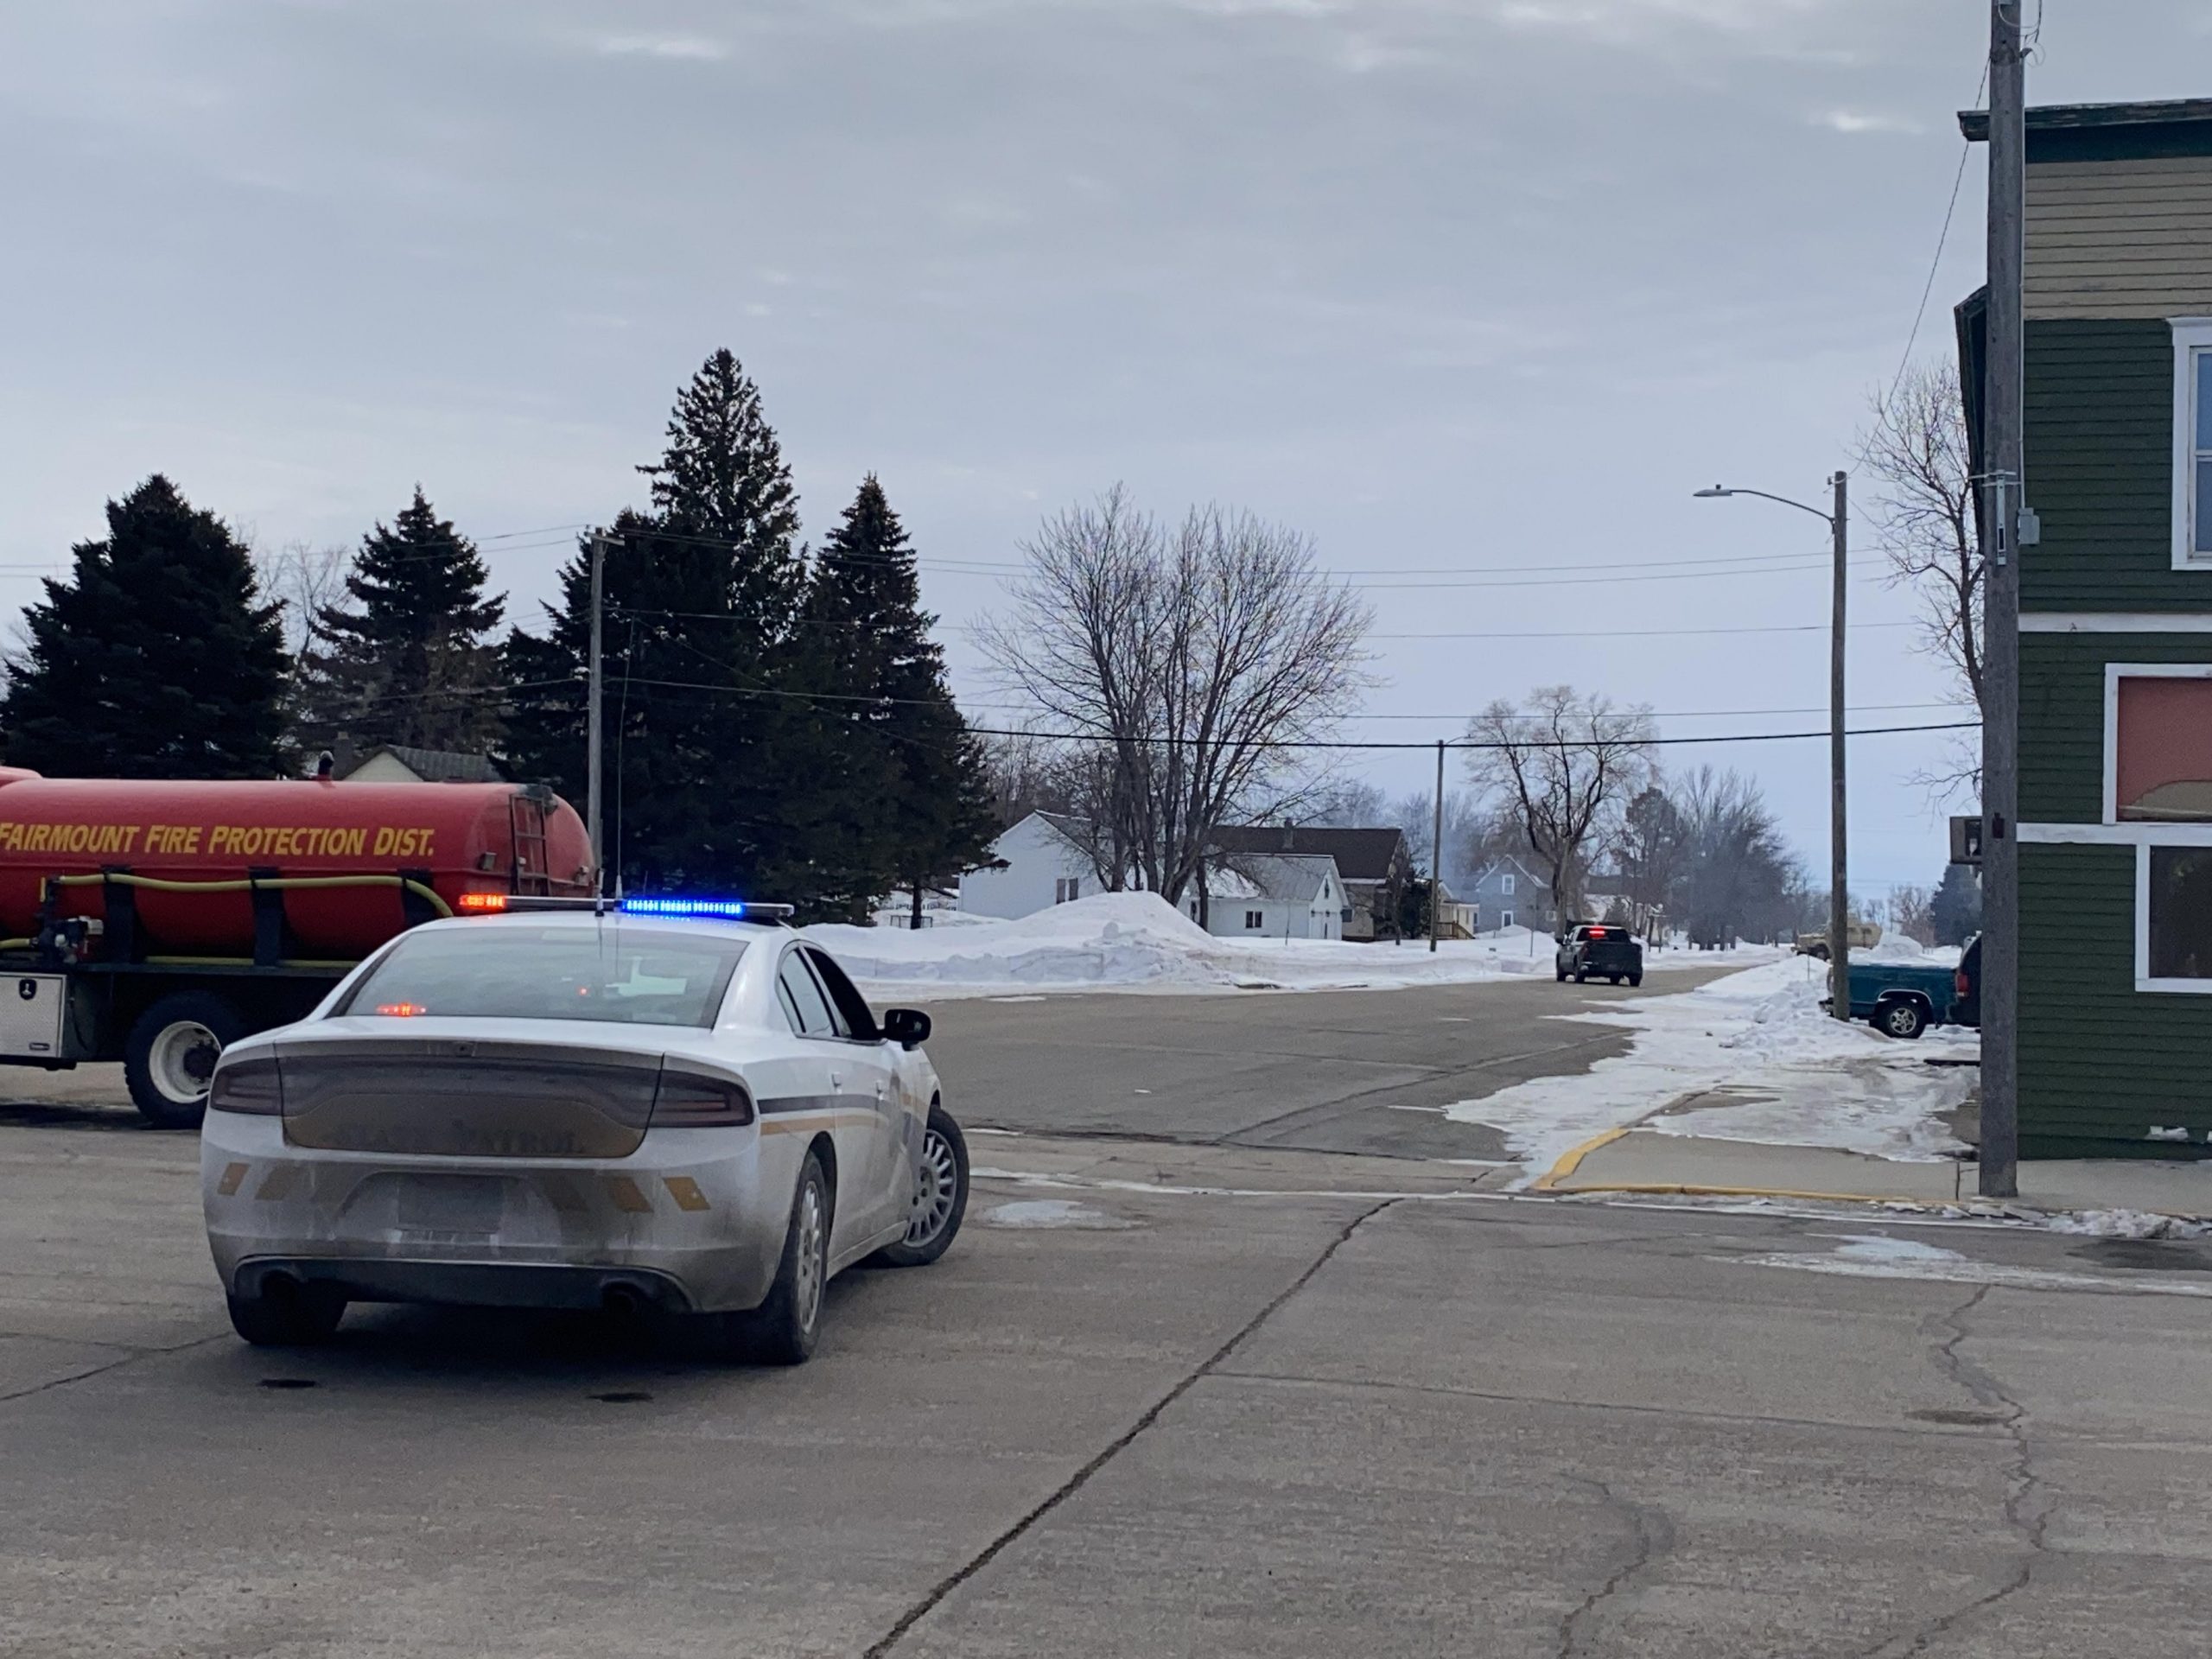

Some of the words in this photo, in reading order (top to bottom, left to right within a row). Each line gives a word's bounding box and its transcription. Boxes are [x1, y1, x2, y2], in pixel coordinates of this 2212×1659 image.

[0, 823, 140, 853] FAIRMOUNT
[144, 824, 203, 854] FIRE
[207, 825, 368, 856] PROTECTION
[373, 827, 435, 856] DIST.
